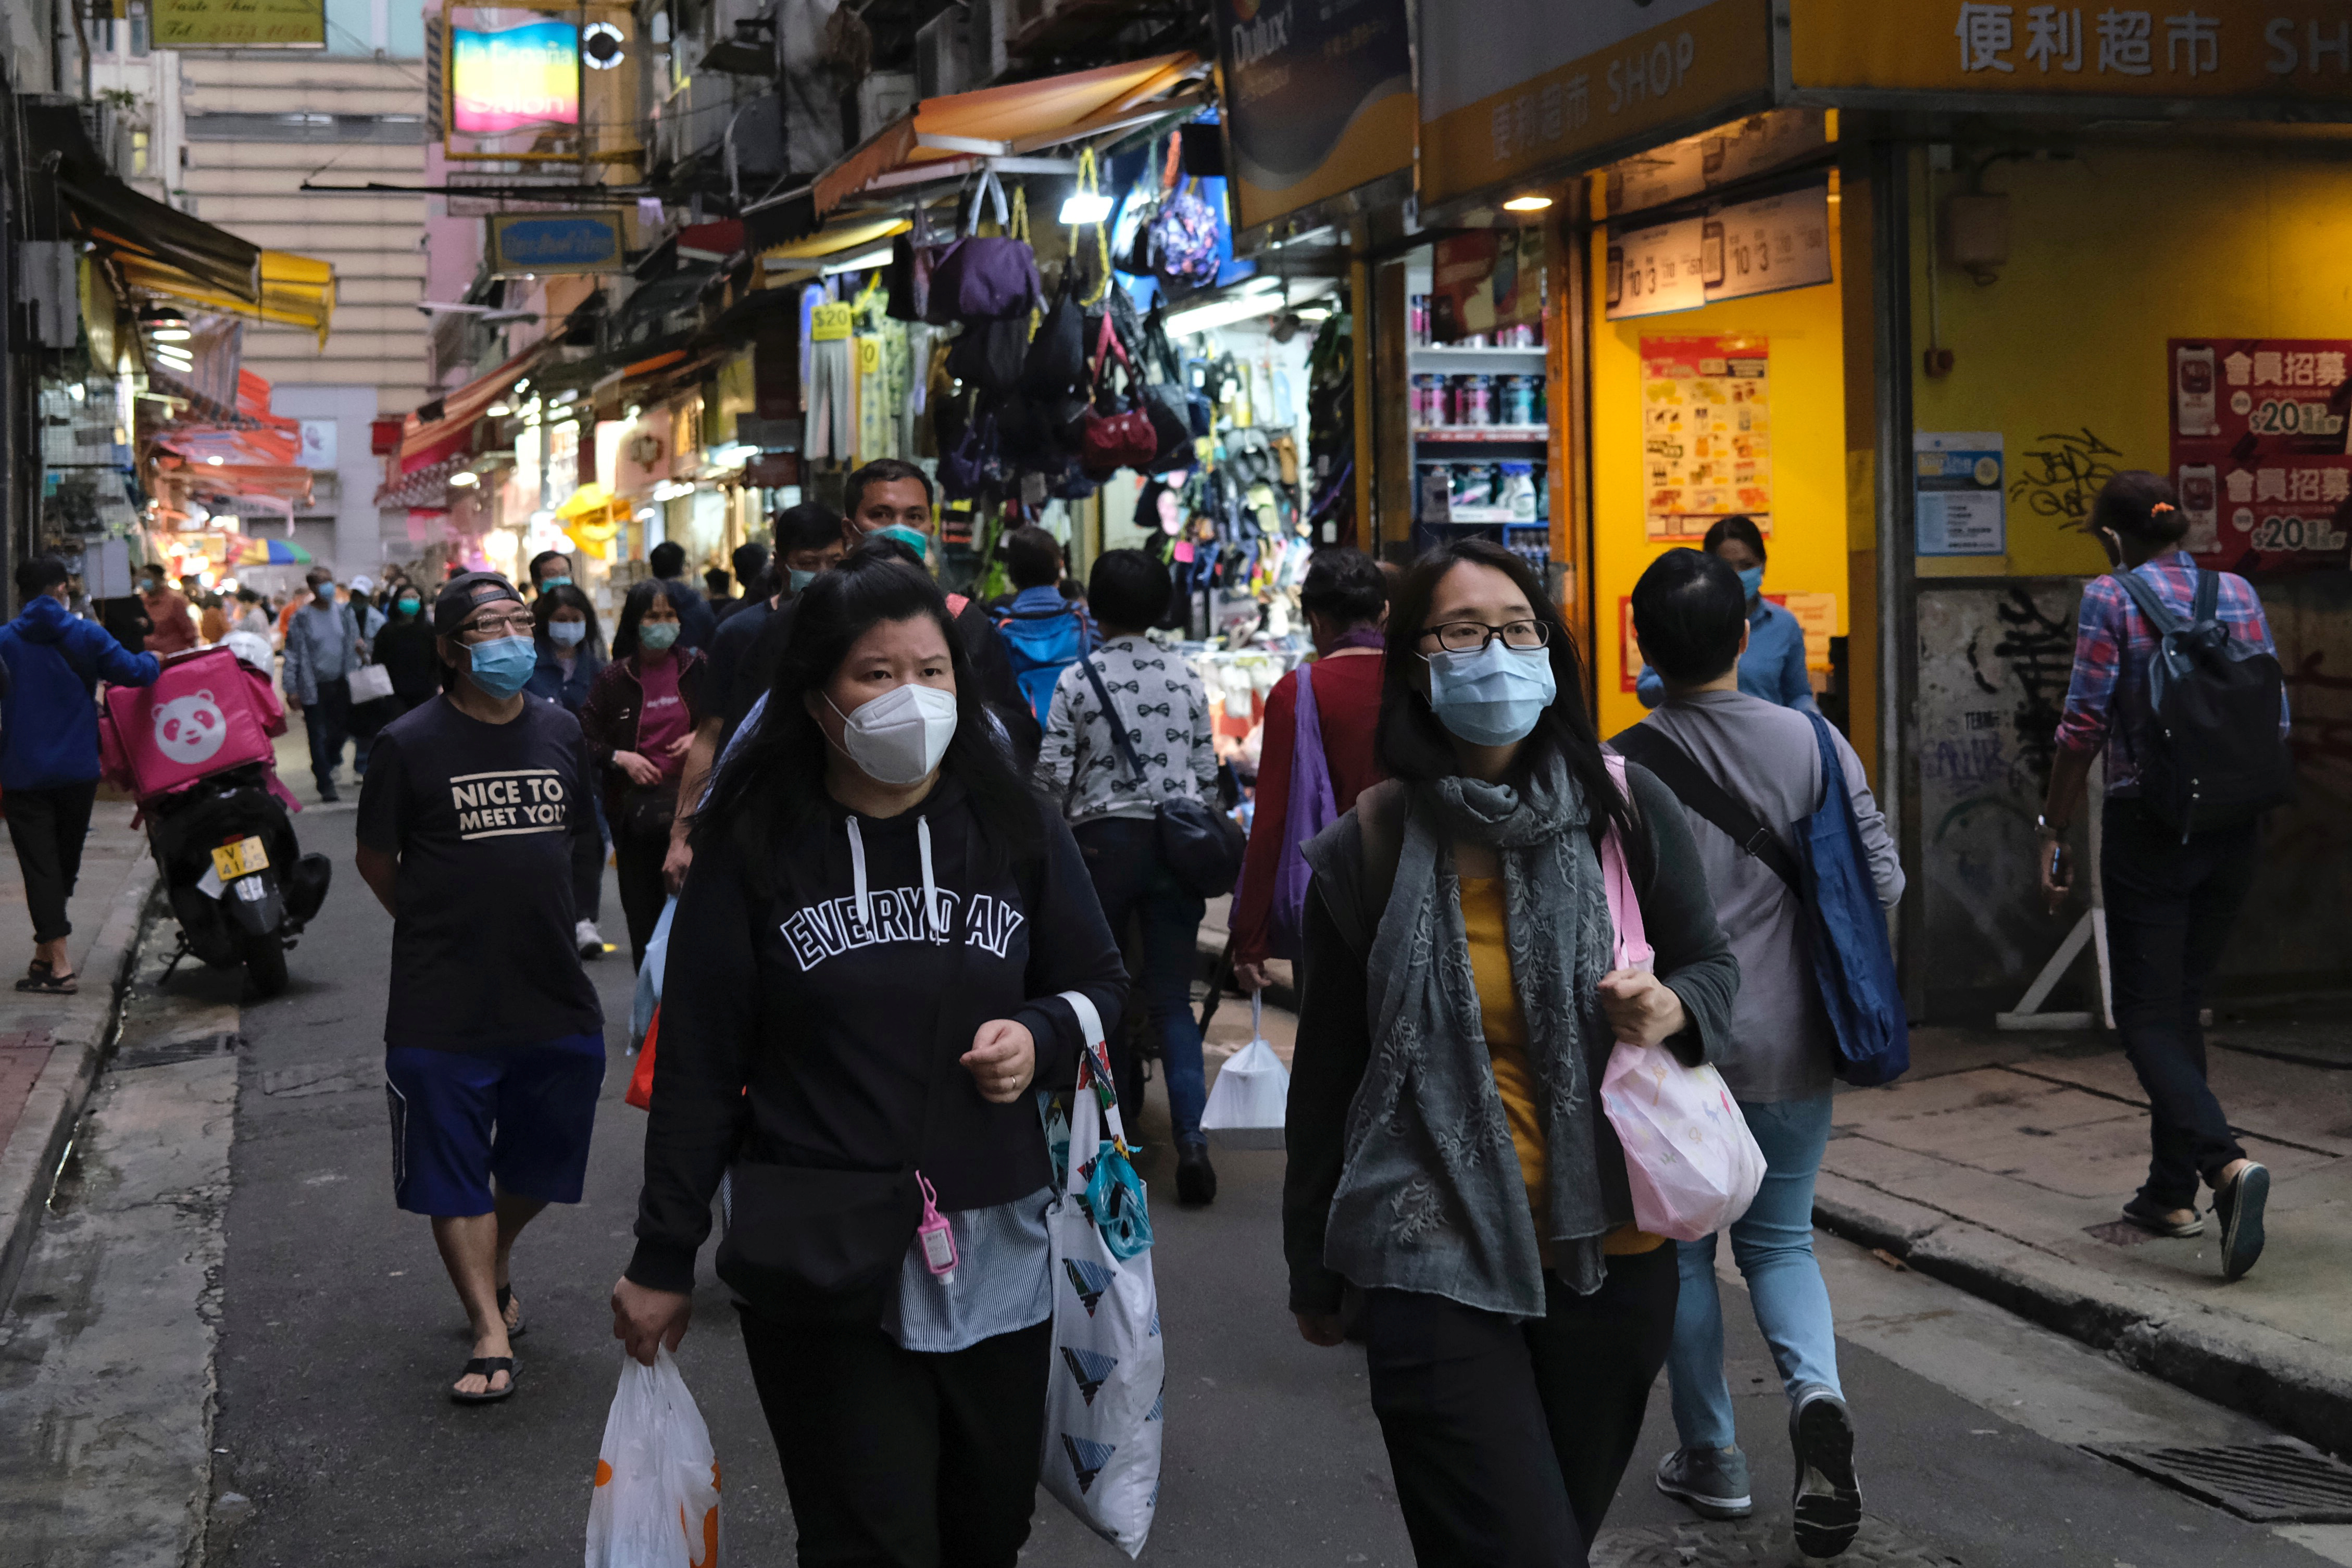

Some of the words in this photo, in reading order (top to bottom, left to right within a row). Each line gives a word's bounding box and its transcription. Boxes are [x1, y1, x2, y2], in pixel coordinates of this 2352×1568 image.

[1954, 1, 2221, 78] 便利超市
[1606, 31, 1695, 115] SHOP
[815, 309, 847, 327] $20
[452, 781, 521, 810] NICE
[527, 778, 564, 802] TO
[459, 807, 518, 831] MEET
[522, 805, 566, 825] YOU
[780, 886, 1024, 972] EVERYDAY
